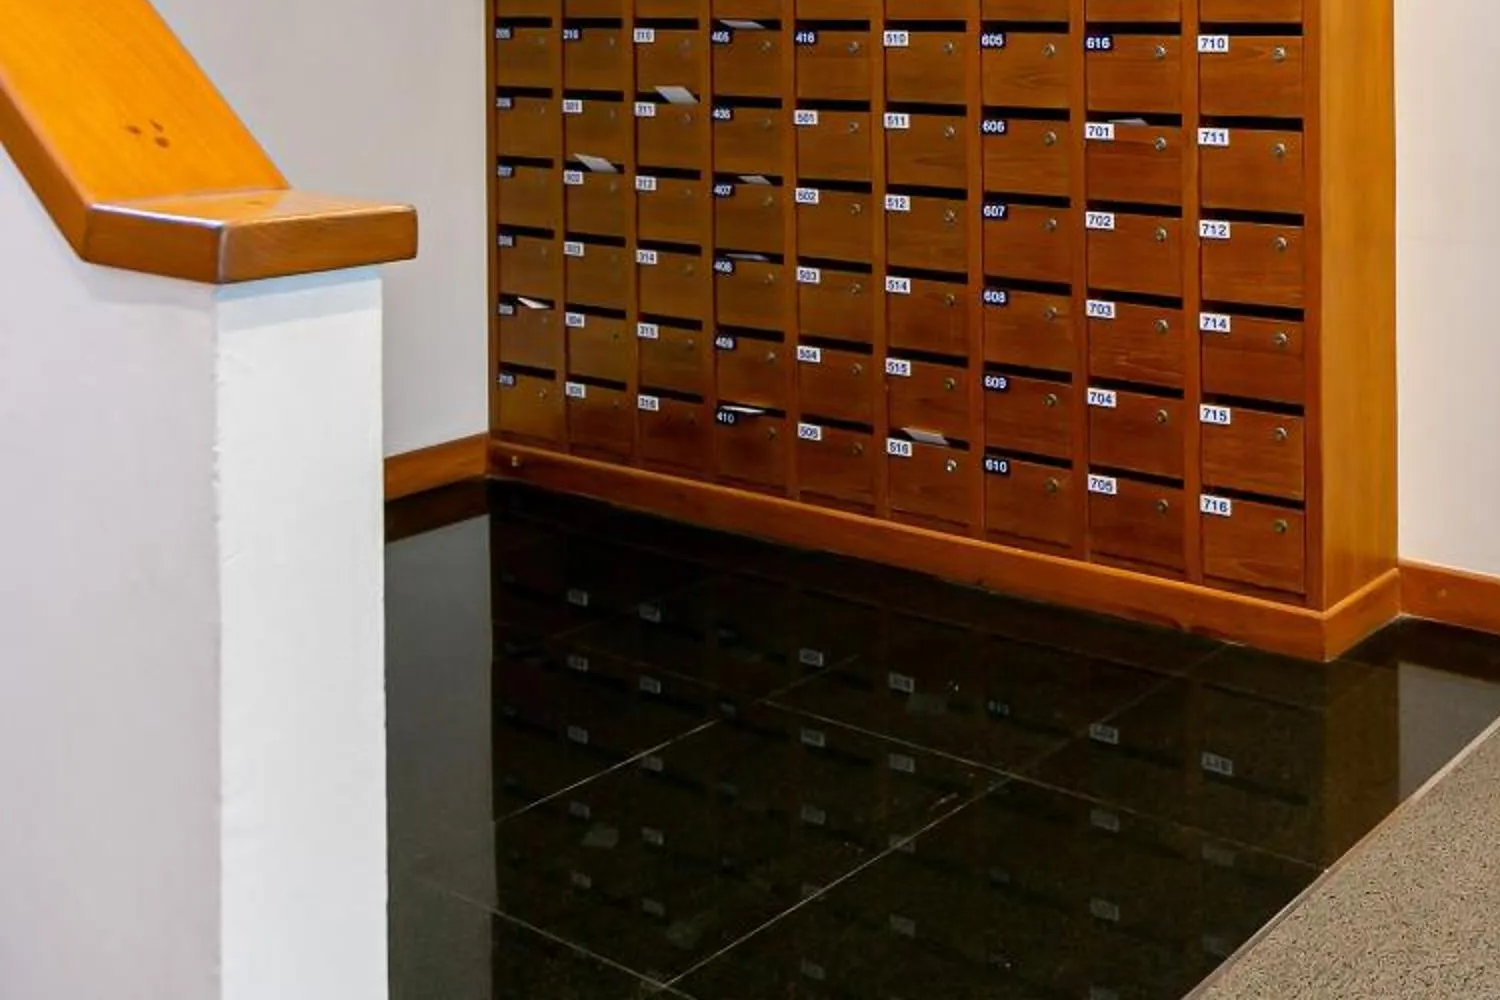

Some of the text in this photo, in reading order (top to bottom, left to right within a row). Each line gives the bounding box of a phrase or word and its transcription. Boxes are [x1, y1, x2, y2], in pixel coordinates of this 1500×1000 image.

[796, 32, 815, 43] 416
[886, 33, 907, 44] 510
[981, 34, 1003, 46] 605
[1086, 37, 1110, 49] 616
[1201, 37, 1226, 50] 710
[887, 115, 906, 127] 511
[982, 120, 1005, 133] 606
[1088, 125, 1109, 137] 701
[1201, 131, 1225, 143] 711
[887, 197, 906, 209] 512
[983, 205, 1005, 217] 607
[1088, 214, 1111, 227] 702
[1201, 223, 1227, 237] 712
[888, 279, 907, 291] 514
[984, 291, 1005, 303] 608
[1089, 302, 1113, 316] 703
[1202, 316, 1227, 330] 714
[887, 361, 907, 374] 515
[985, 376, 1006, 389] 609
[1089, 391, 1113, 404] 704
[717, 412, 734, 423] 410
[1202, 407, 1228, 422] 715
[889, 441, 909, 455] 516
[985, 459, 1007, 473] 610
[1091, 477, 1113, 493] 705
[1203, 497, 1229, 513] 716
